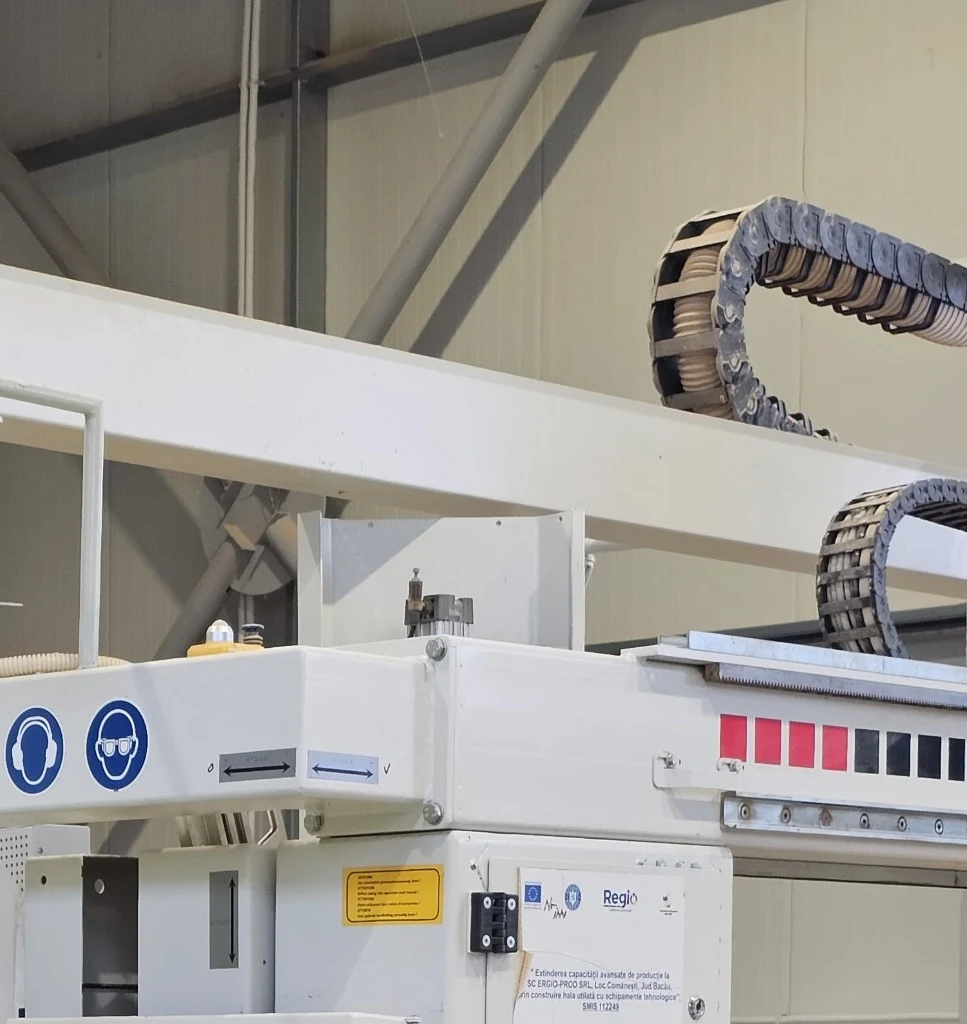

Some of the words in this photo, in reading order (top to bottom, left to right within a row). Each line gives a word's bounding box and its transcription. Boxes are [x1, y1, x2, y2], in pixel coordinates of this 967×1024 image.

[603, 889, 638, 908] Regio
[535, 969, 567, 977] Extinderea
[600, 971, 626, 979] avansate
[627, 971, 635, 979] de
[527, 980, 536, 988] SC
[531, 991, 562, 999] construire
[605, 993, 642, 1002] echipamente
[582, 1002, 598, 1011] SMIS
[599, 1002, 620, 1011] 112249
